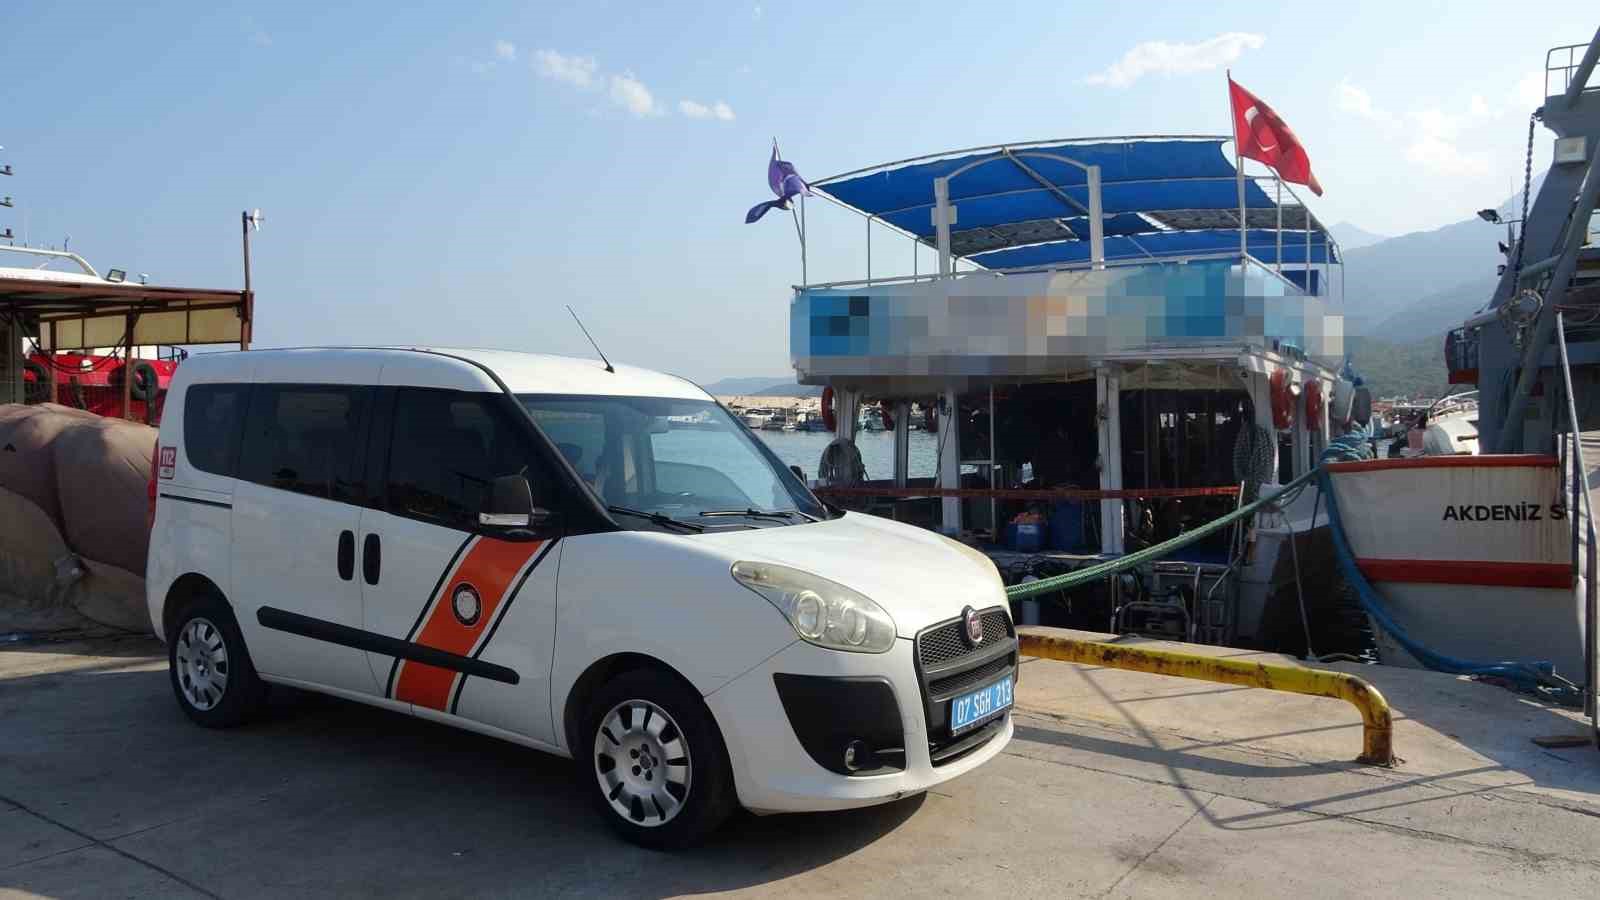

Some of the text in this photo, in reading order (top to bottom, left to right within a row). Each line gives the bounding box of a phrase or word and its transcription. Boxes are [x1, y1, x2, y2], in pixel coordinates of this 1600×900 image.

[162, 449, 174, 465] 112
[1443, 501, 1542, 521] AKDENİZ
[957, 680, 1011, 723] 07 SGH 213
